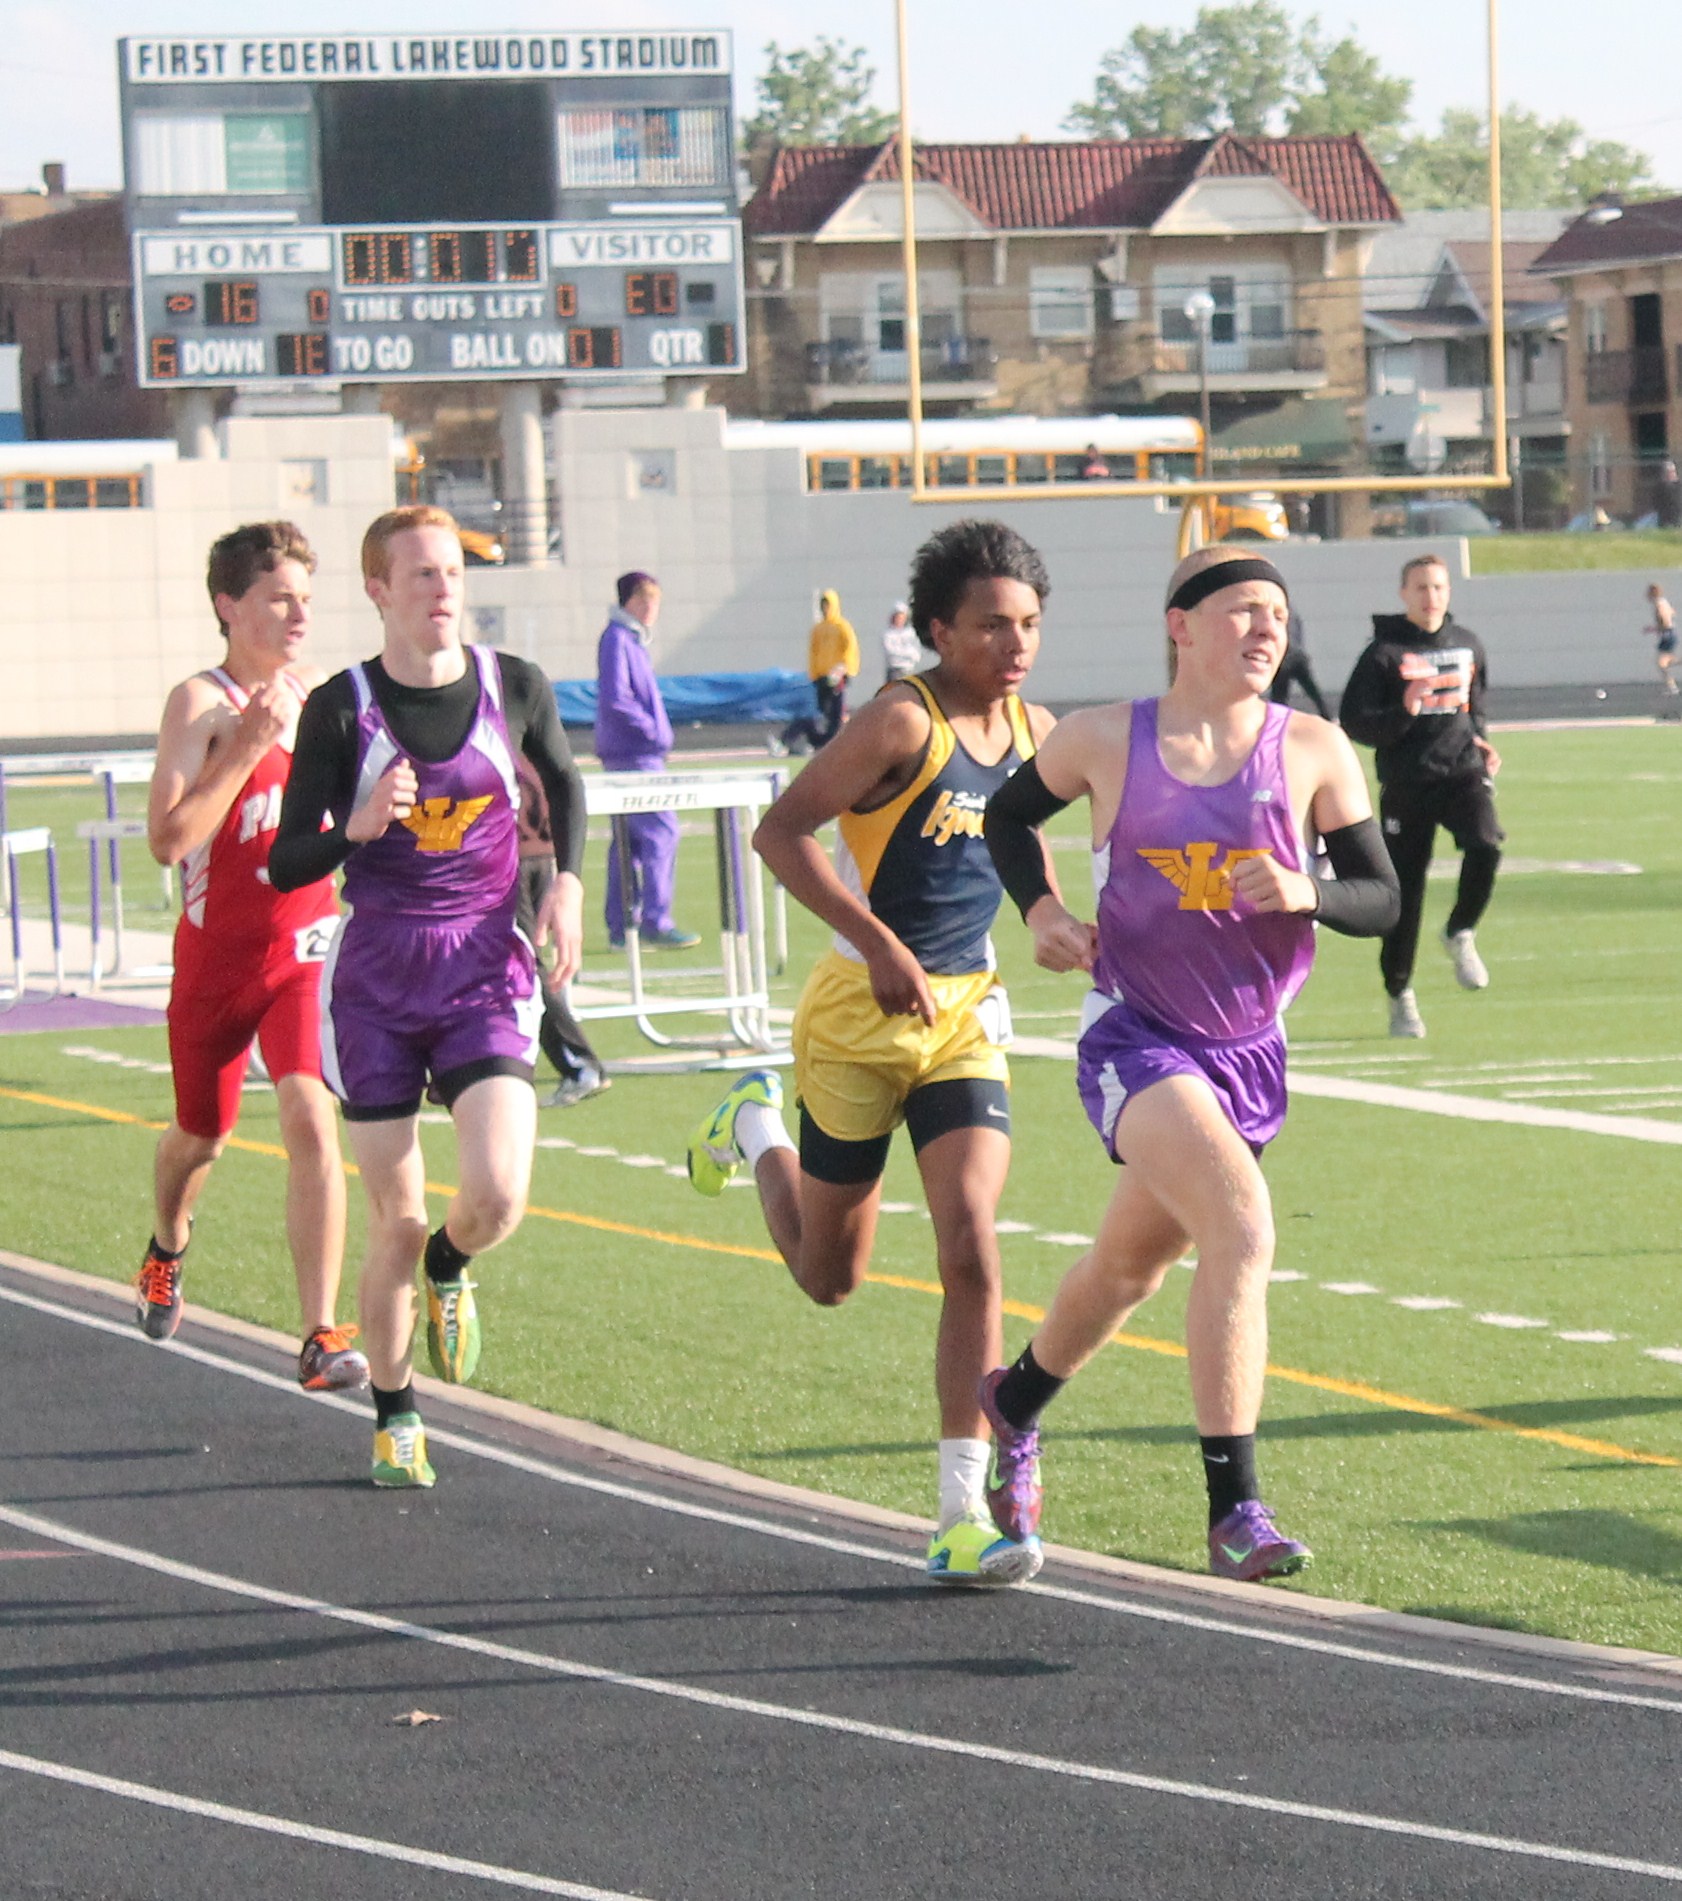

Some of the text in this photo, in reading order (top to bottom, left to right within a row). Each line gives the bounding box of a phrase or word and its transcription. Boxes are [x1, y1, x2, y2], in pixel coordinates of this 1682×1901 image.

[138, 36, 719, 75] FIRST FEDERAL LAKEWOOD STADIUM
[174, 243, 303, 270] HOME
[570, 233, 713, 260] VISITOR
[221, 282, 258, 324] 16
[341, 294, 546, 322] TIME OUTS LEFT
[181, 338, 266, 376] DOWN
[334, 334, 414, 372] TO GO
[450, 331, 567, 369] BALL ON
[649, 328, 704, 367] QTR
[239, 783, 284, 844] PA
